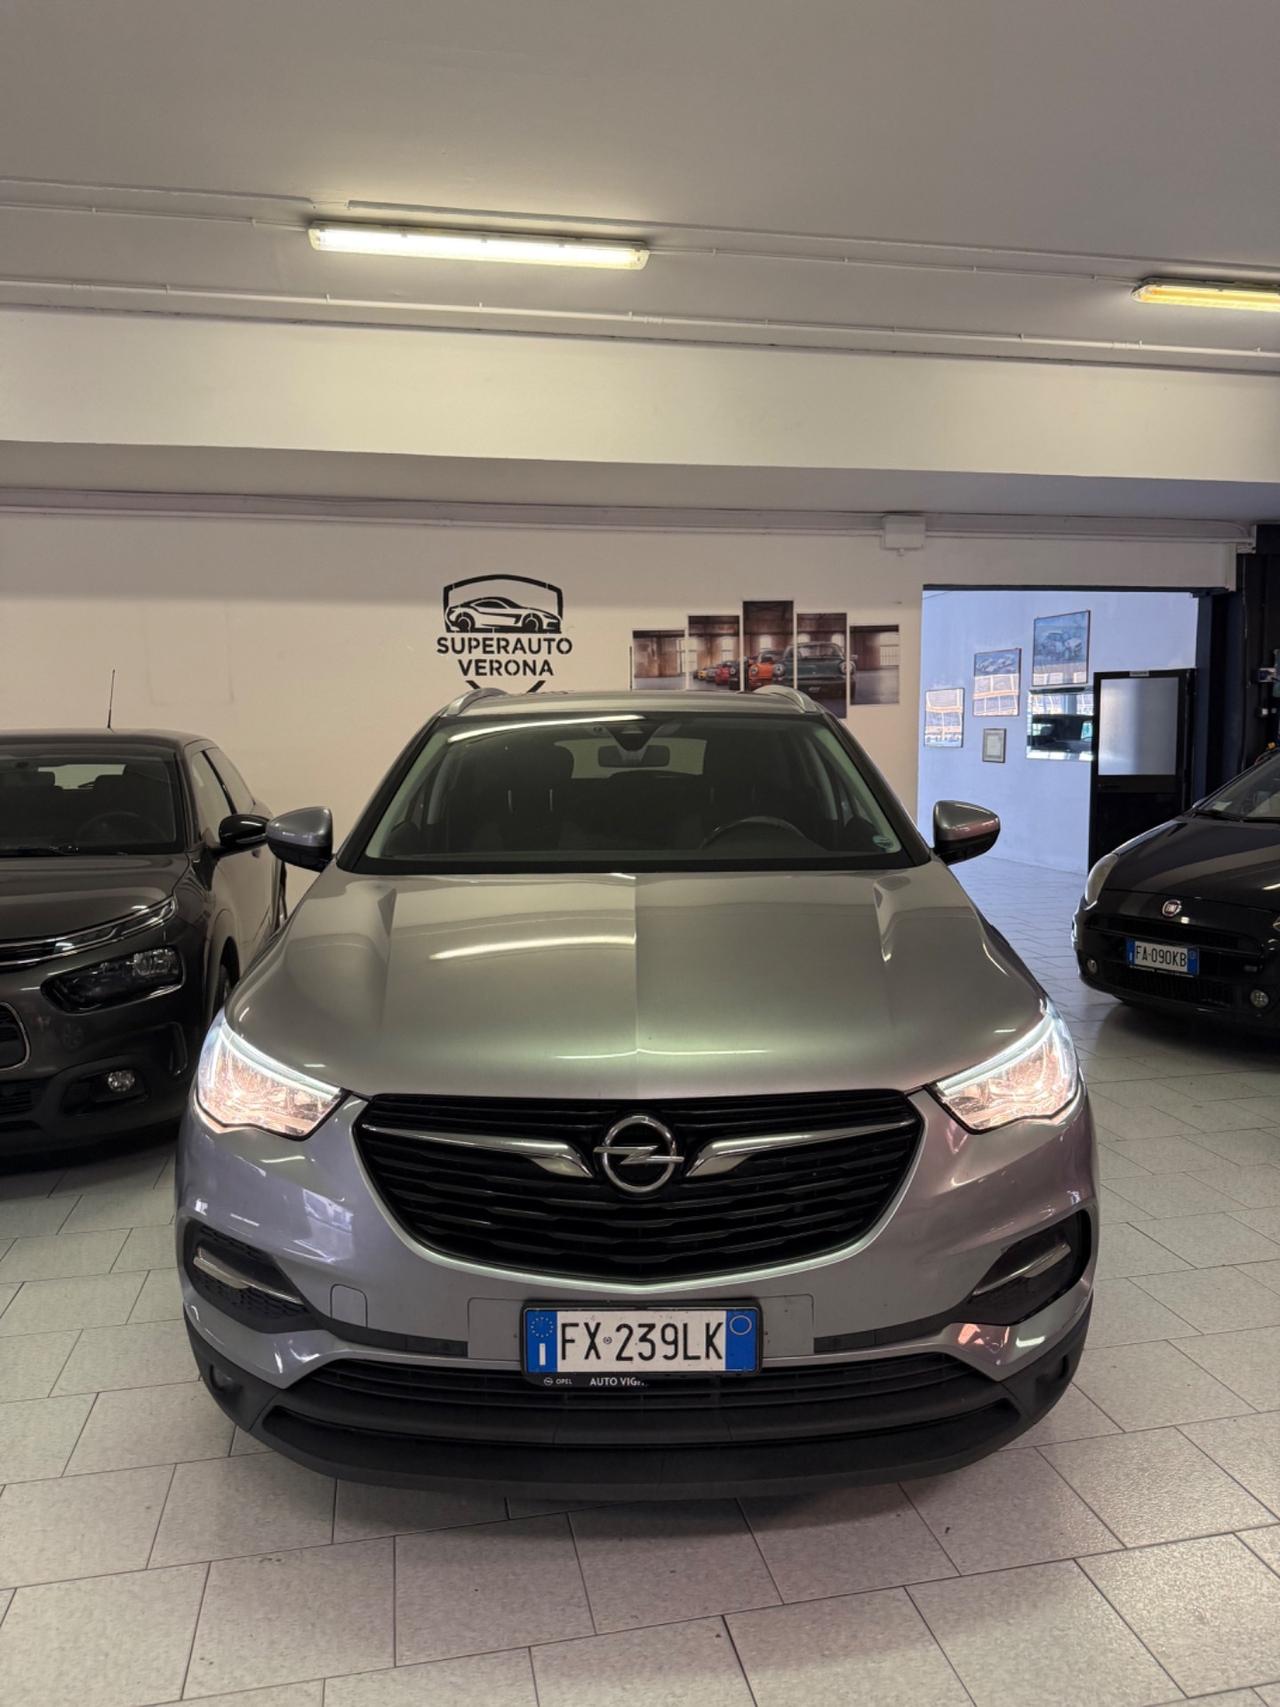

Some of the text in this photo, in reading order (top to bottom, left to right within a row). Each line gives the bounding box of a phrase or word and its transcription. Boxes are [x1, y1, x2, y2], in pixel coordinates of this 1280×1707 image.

[436, 637, 573, 655] SUPERAUTO
[457, 659, 554, 677] VERONA
[589, 1377, 617, 1386] AUTO
